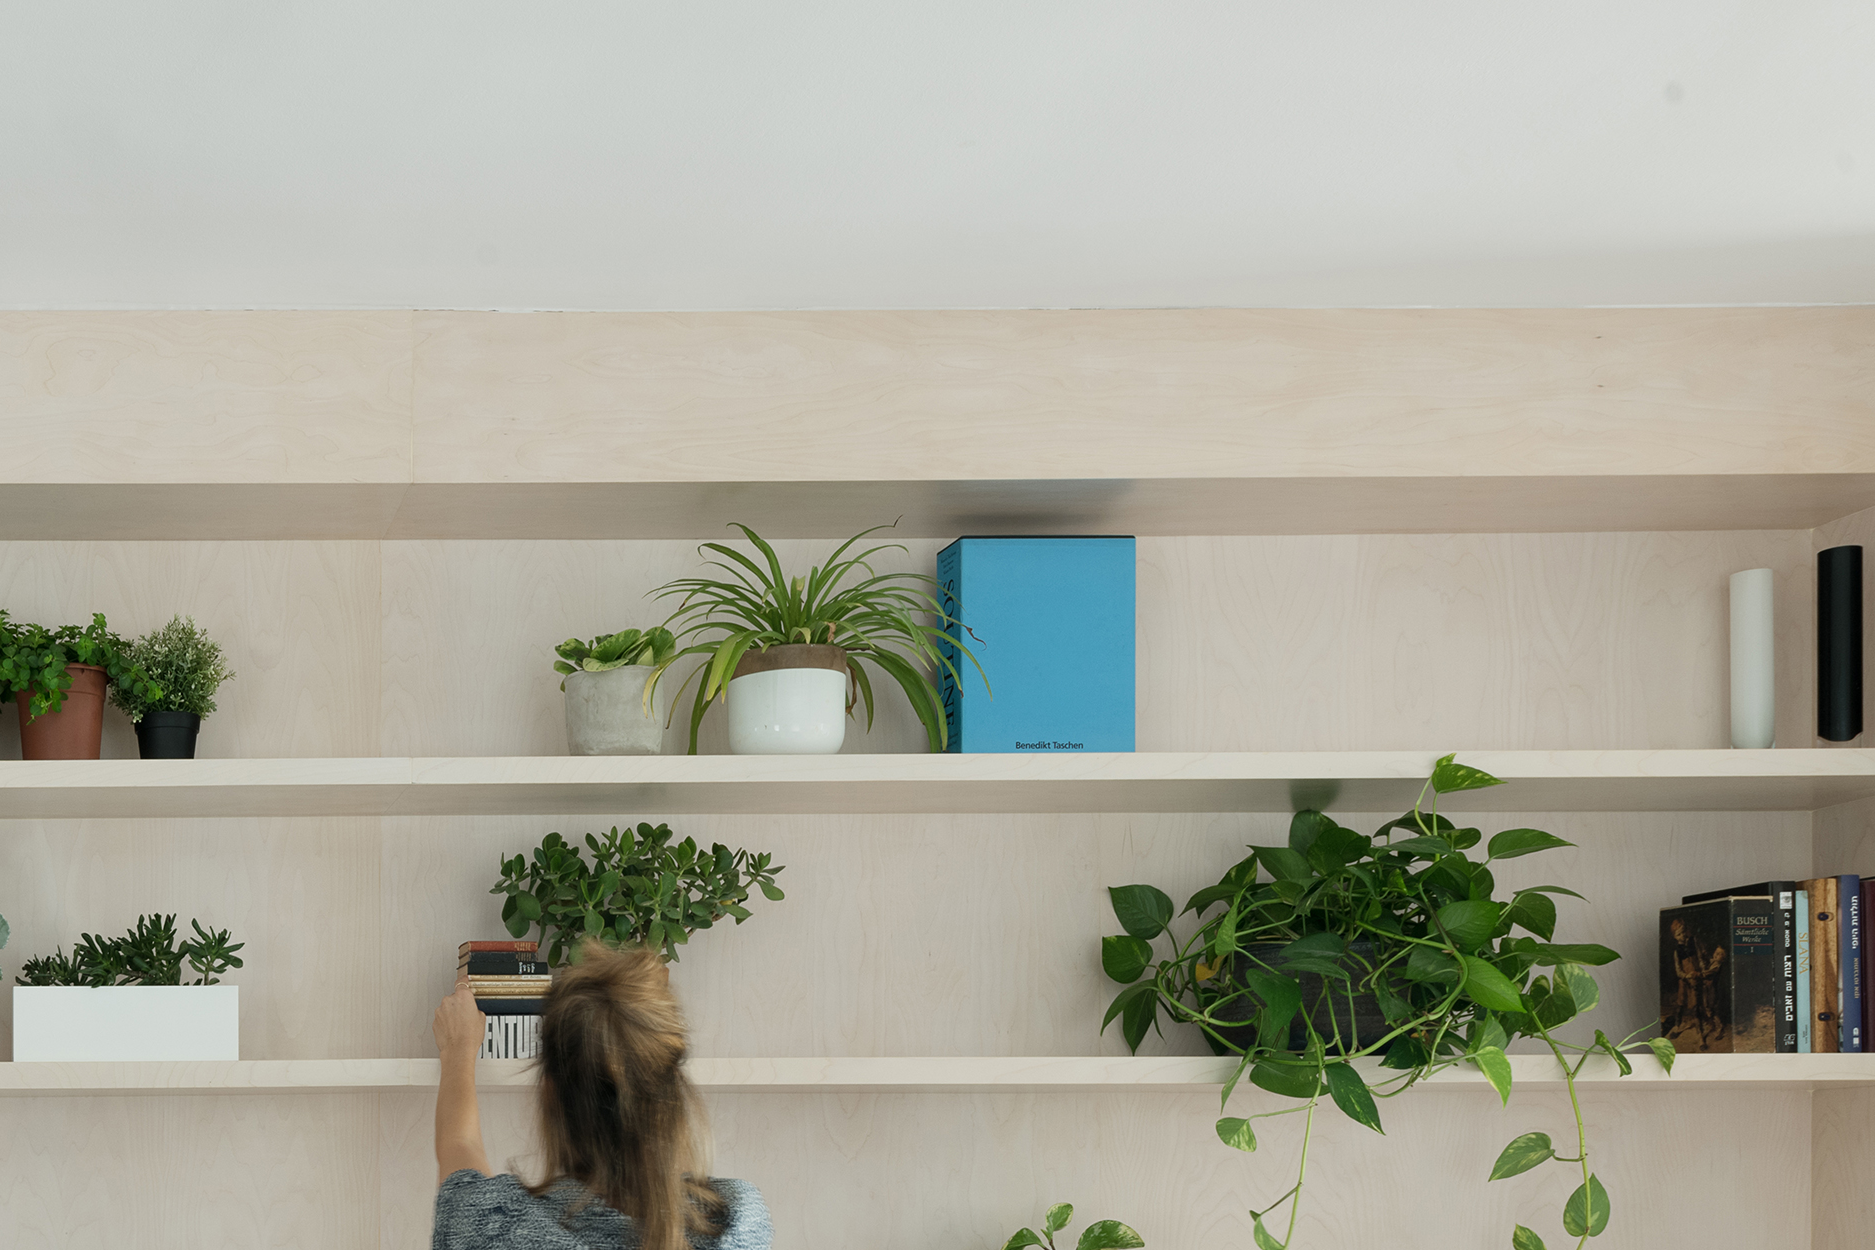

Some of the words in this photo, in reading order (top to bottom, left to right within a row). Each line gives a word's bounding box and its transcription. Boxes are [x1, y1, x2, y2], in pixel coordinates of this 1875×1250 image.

[1015, 741, 1051, 749] Benedikt
[1052, 741, 1084, 749] Taschen
[1736, 916, 1768, 925] BUSCH
[1849, 895, 1858, 926] תולדות
[1850, 928, 1859, 949] היופי
[1798, 932, 1809, 975] SLANA
